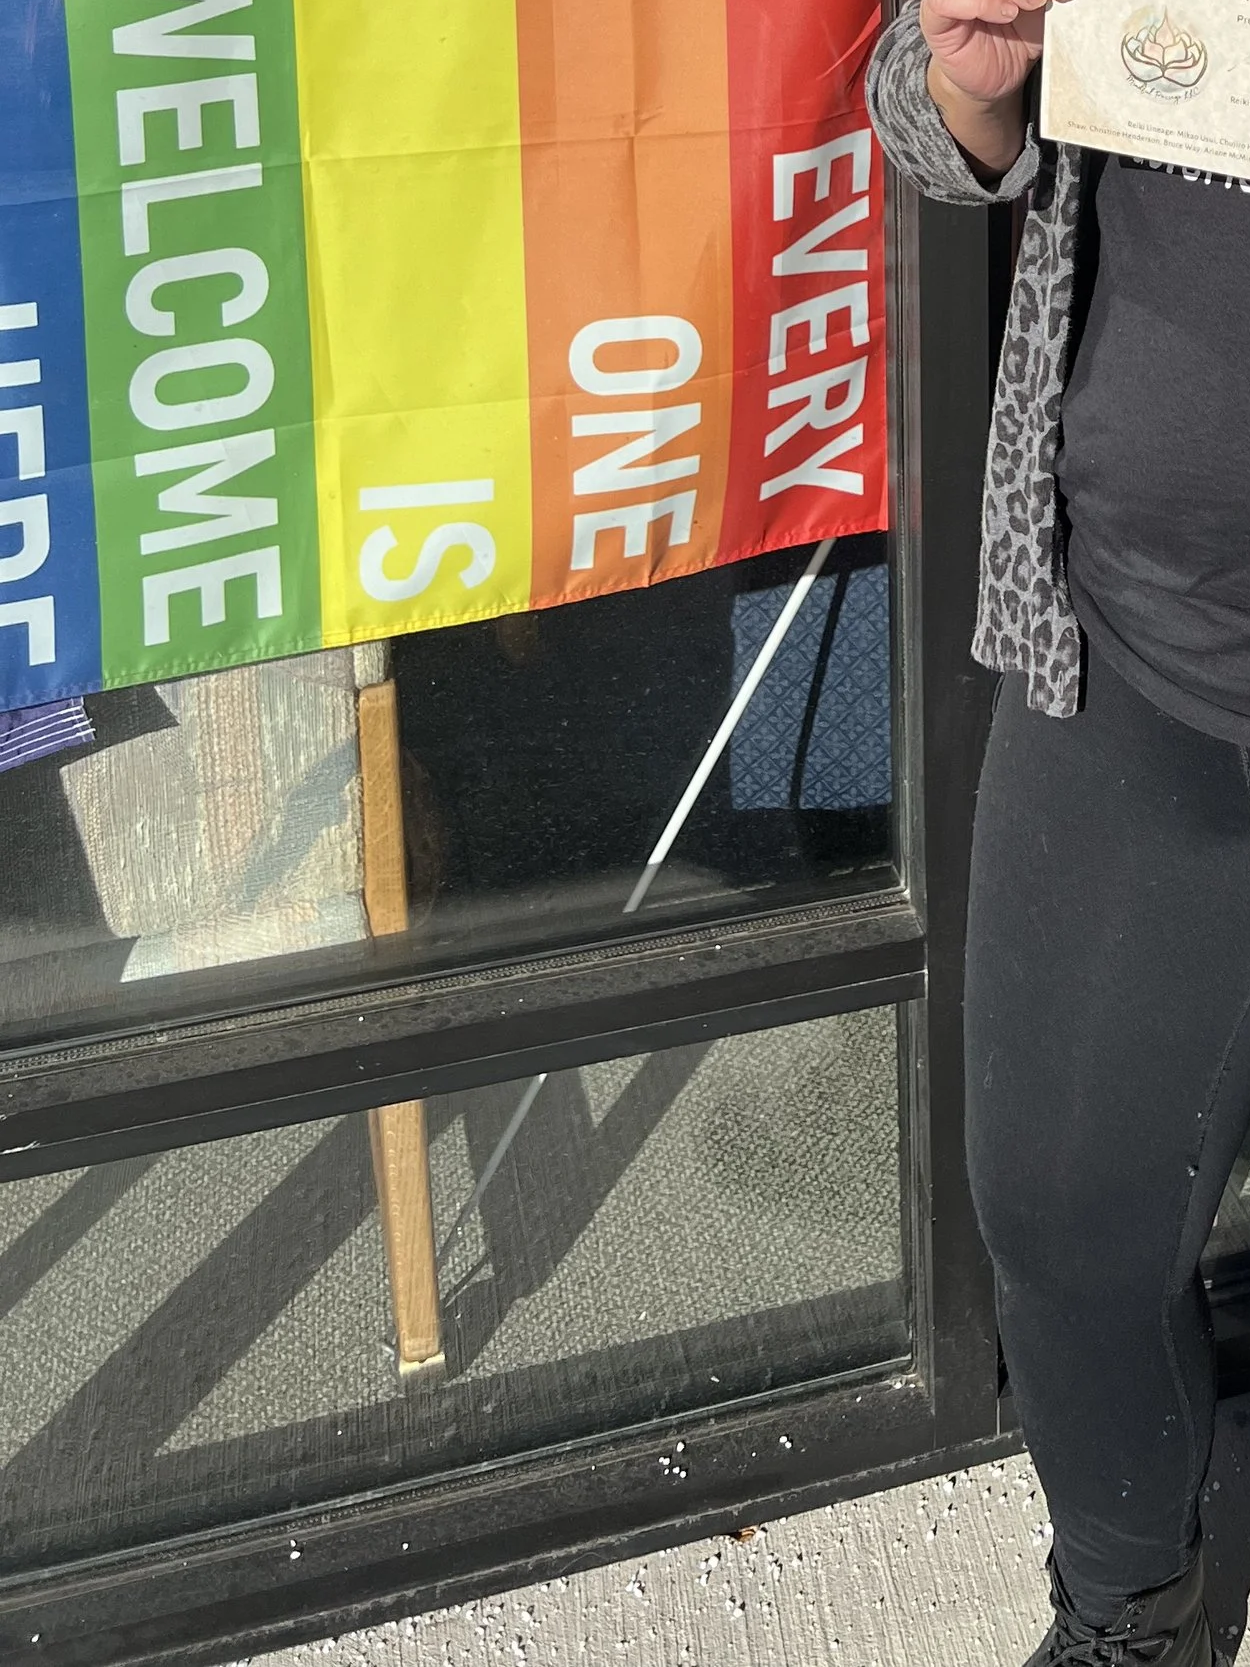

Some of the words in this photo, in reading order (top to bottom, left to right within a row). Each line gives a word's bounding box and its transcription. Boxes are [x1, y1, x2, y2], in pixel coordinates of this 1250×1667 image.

[1089, 125, 1121, 137] Christine
[1163, 138, 1184, 150] Bruce
[1127, 120, 1145, 130] Reiki
[1176, 130, 1199, 140] Mikao
[1219, 138, 1246, 151] Chujiro
[1230, 96, 1250, 107] Reiki
[760, 128, 873, 503] EVERY
[568, 315, 704, 572] ONE
[358, 478, 497, 602] IS
